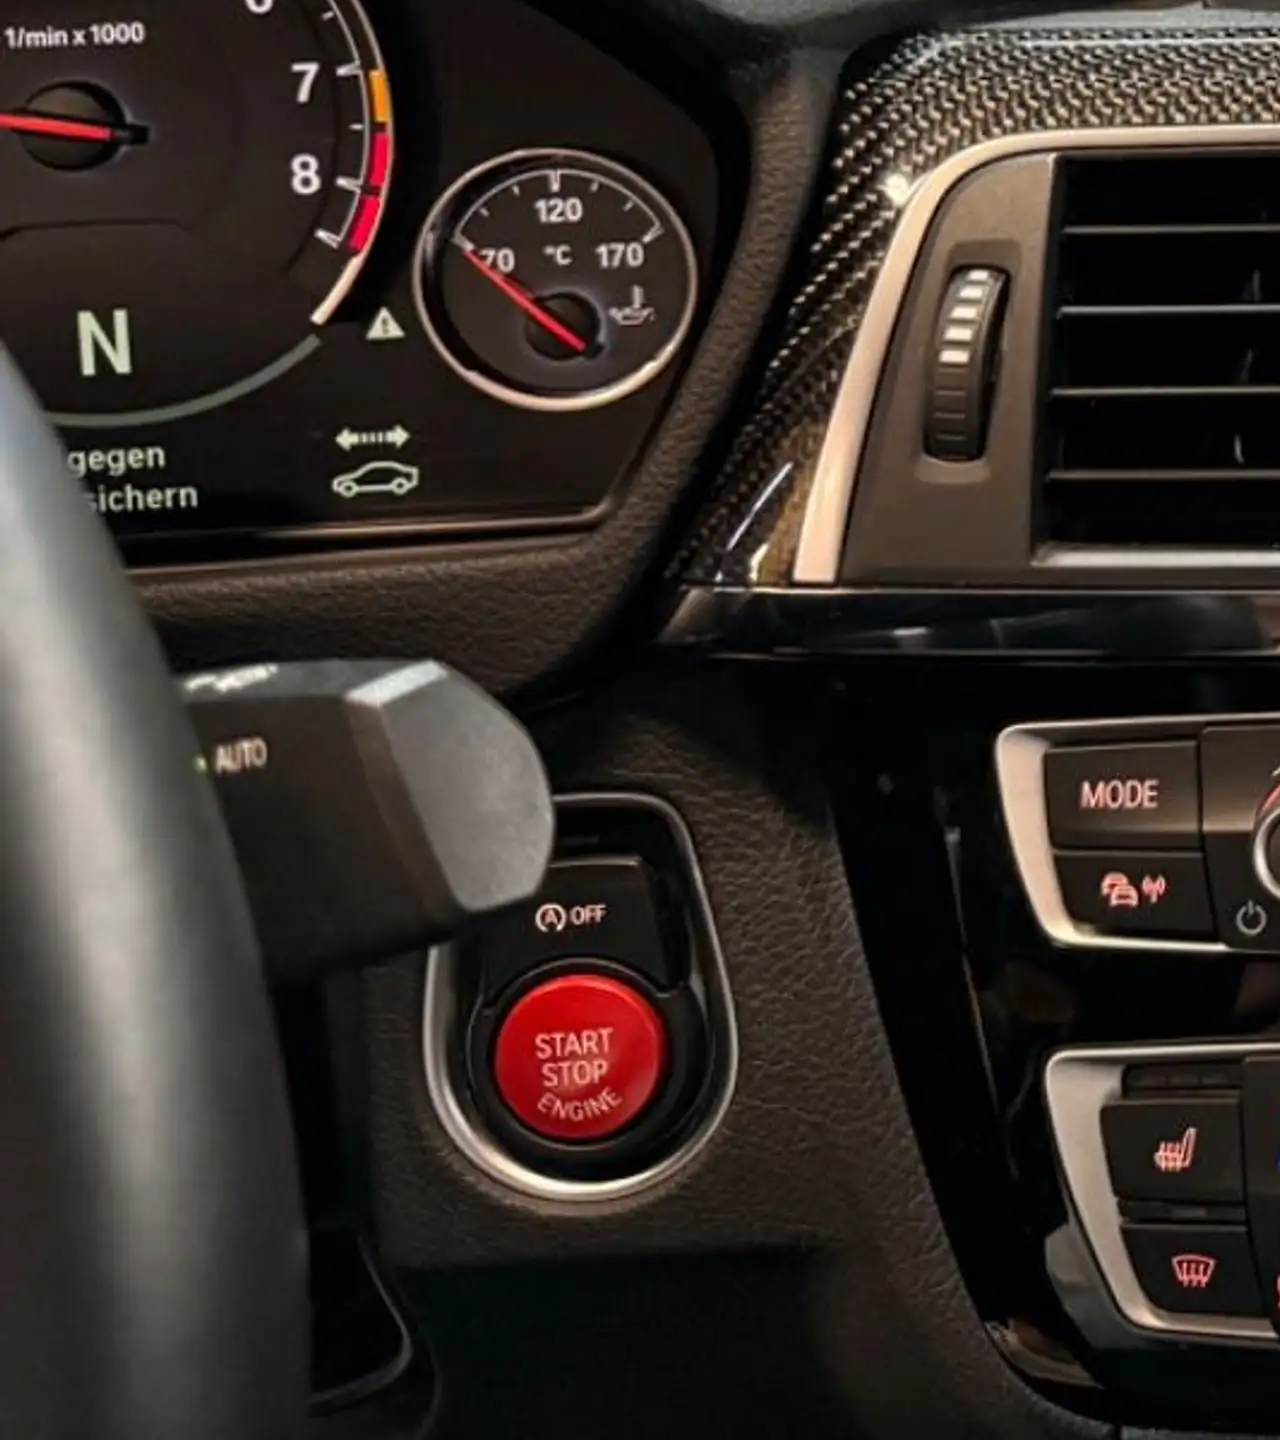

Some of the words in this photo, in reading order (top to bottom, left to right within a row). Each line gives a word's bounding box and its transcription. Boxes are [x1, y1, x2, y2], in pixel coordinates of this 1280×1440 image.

[4, 25, 69, 49] 1/min
[291, 61, 320, 103] 7
[291, 153, 321, 195] 8
[534, 197, 583, 223] 120
[483, 247, 515, 273] 70
[543, 244, 573, 266] °C
[594, 242, 644, 269] 170
[77, 308, 132, 376] N
[66, 445, 167, 477] gegen
[214, 737, 268, 773] AUTO
[1081, 779, 1159, 810] MODE
[569, 903, 607, 926] OFF
[534, 1027, 614, 1059] START
[541, 1059, 610, 1088] STOP
[536, 1087, 623, 1122] ENGINE
